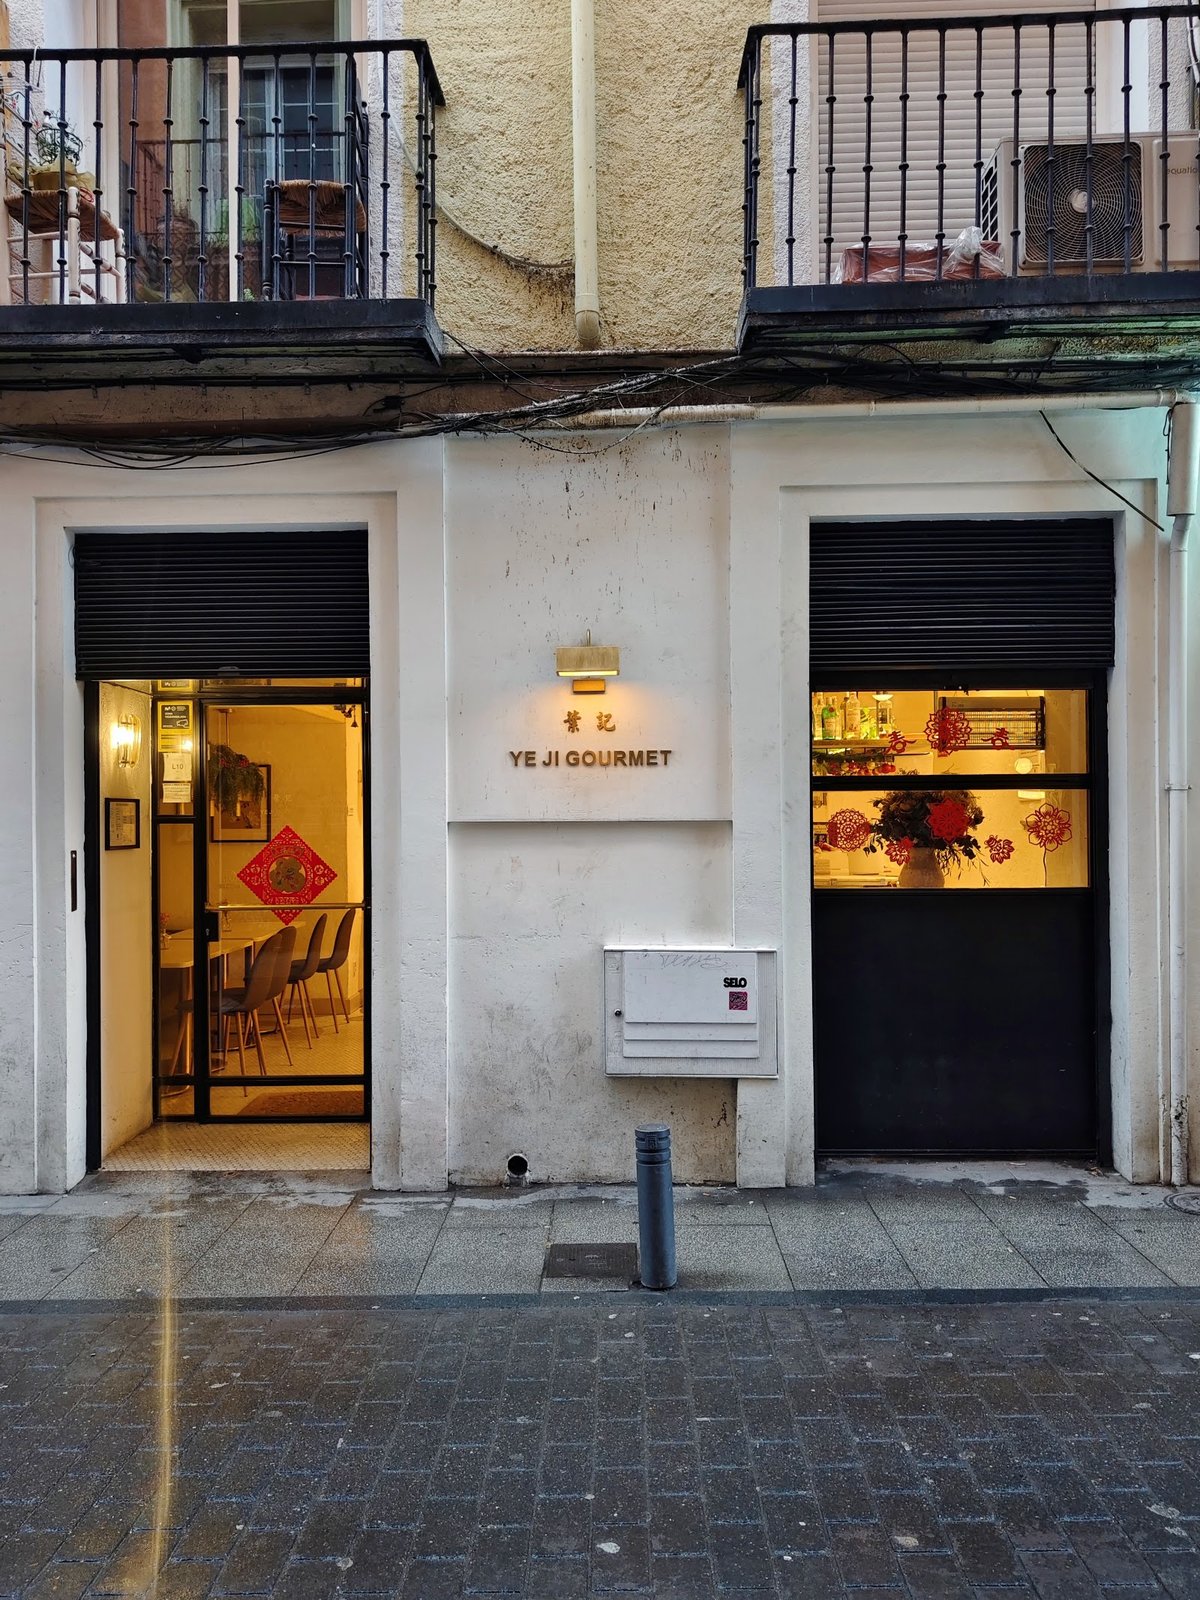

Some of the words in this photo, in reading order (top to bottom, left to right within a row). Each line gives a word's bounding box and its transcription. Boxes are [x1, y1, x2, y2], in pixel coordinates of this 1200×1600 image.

[510, 751, 536, 767] YE
[543, 751, 559, 767] JI
[566, 750, 672, 767] GOURMET
[723, 977, 747, 988] SELO
